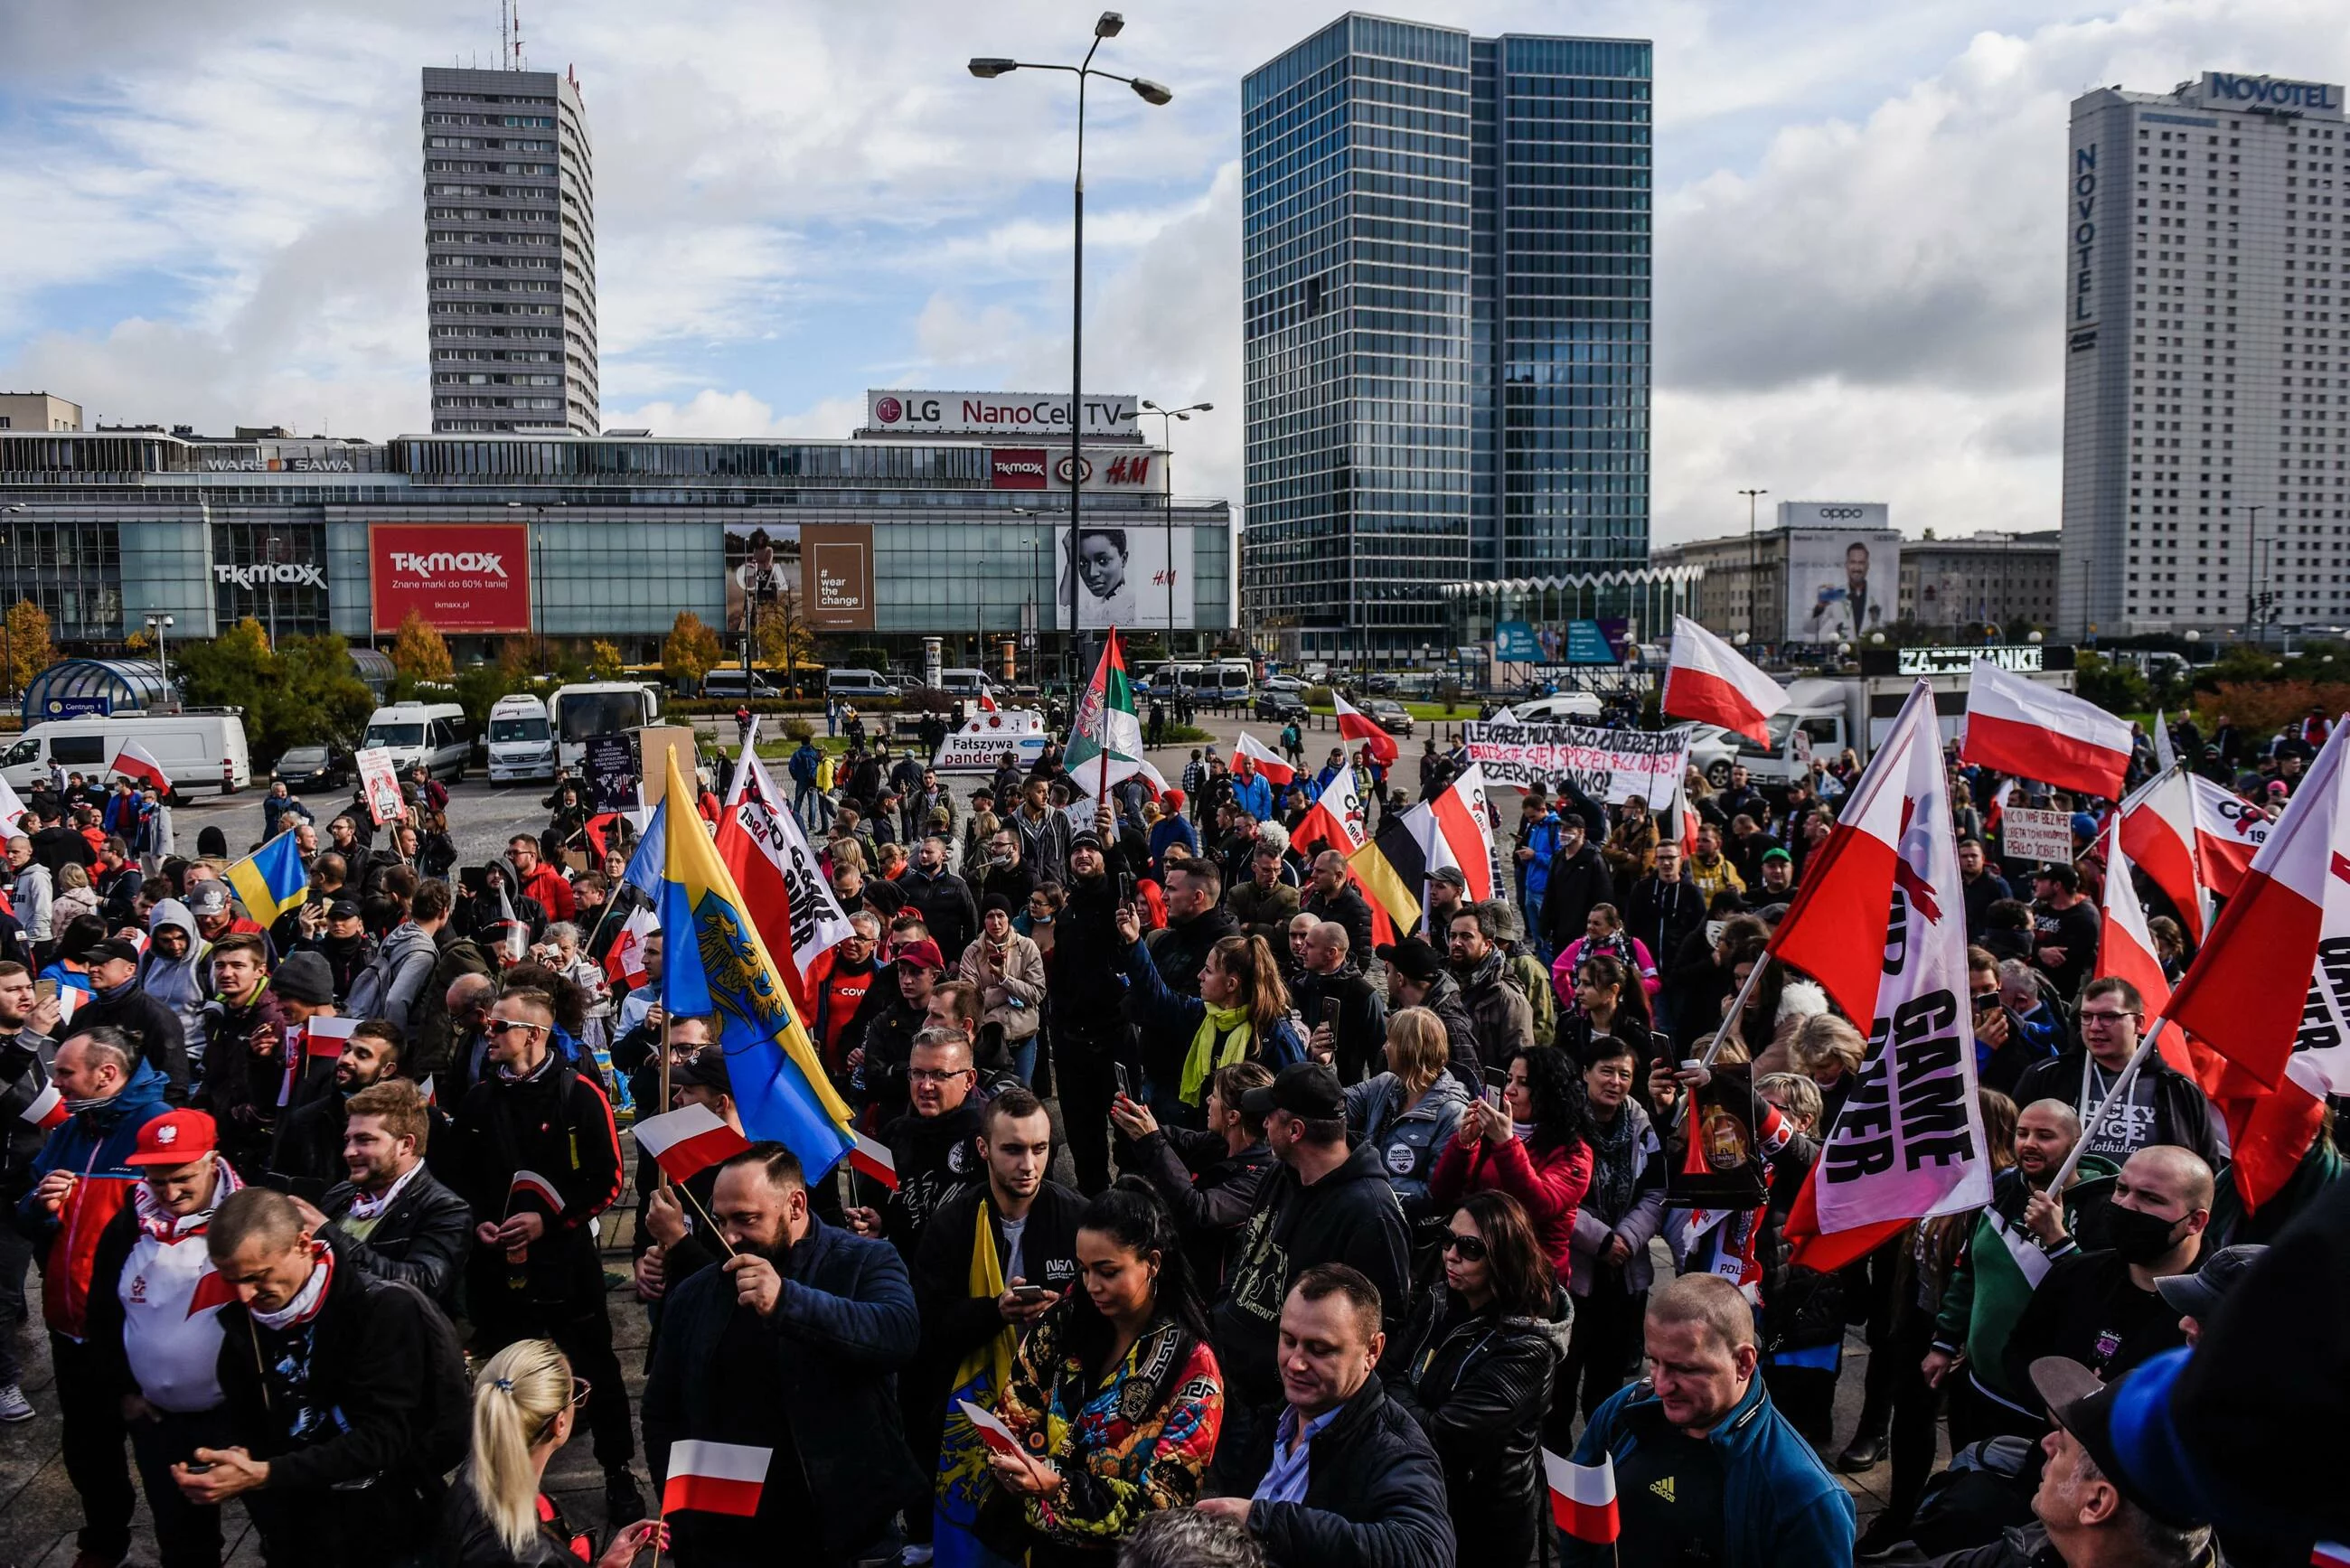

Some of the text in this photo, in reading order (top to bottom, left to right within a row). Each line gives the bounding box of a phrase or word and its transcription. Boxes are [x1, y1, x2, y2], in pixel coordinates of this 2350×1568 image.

[2213, 72, 2338, 109] NOVOTEL
[2076, 143, 2097, 322] NOVOTEL
[906, 399, 1122, 426] LG NanoCel TV
[208, 459, 354, 472] WARS SAWA
[1105, 455, 1151, 486] H&M
[1819, 508, 1864, 521] oppo
[736, 562, 789, 591] C&A
[821, 568, 828, 578] #
[821, 577, 847, 587] wear
[392, 579, 420, 589] Znane
[422, 579, 446, 589] marki
[448, 579, 460, 588] do
[462, 579, 483, 588] 60%
[821, 586, 839, 596] the
[434, 601, 470, 609] tkmaxx.pl
[821, 596, 859, 608] change
[65, 703, 95, 711] Centrum
[953, 738, 1014, 751] Fałszywa
[945, 750, 1020, 766] pandema
[739, 806, 768, 844] 1984
[1347, 822, 1363, 846] 1984
[790, 845, 840, 923] GAME
[1893, 989, 1976, 1173] GAME
[2097, 1119, 2146, 1141] ICE
[1649, 1483, 1676, 1503] adidas
